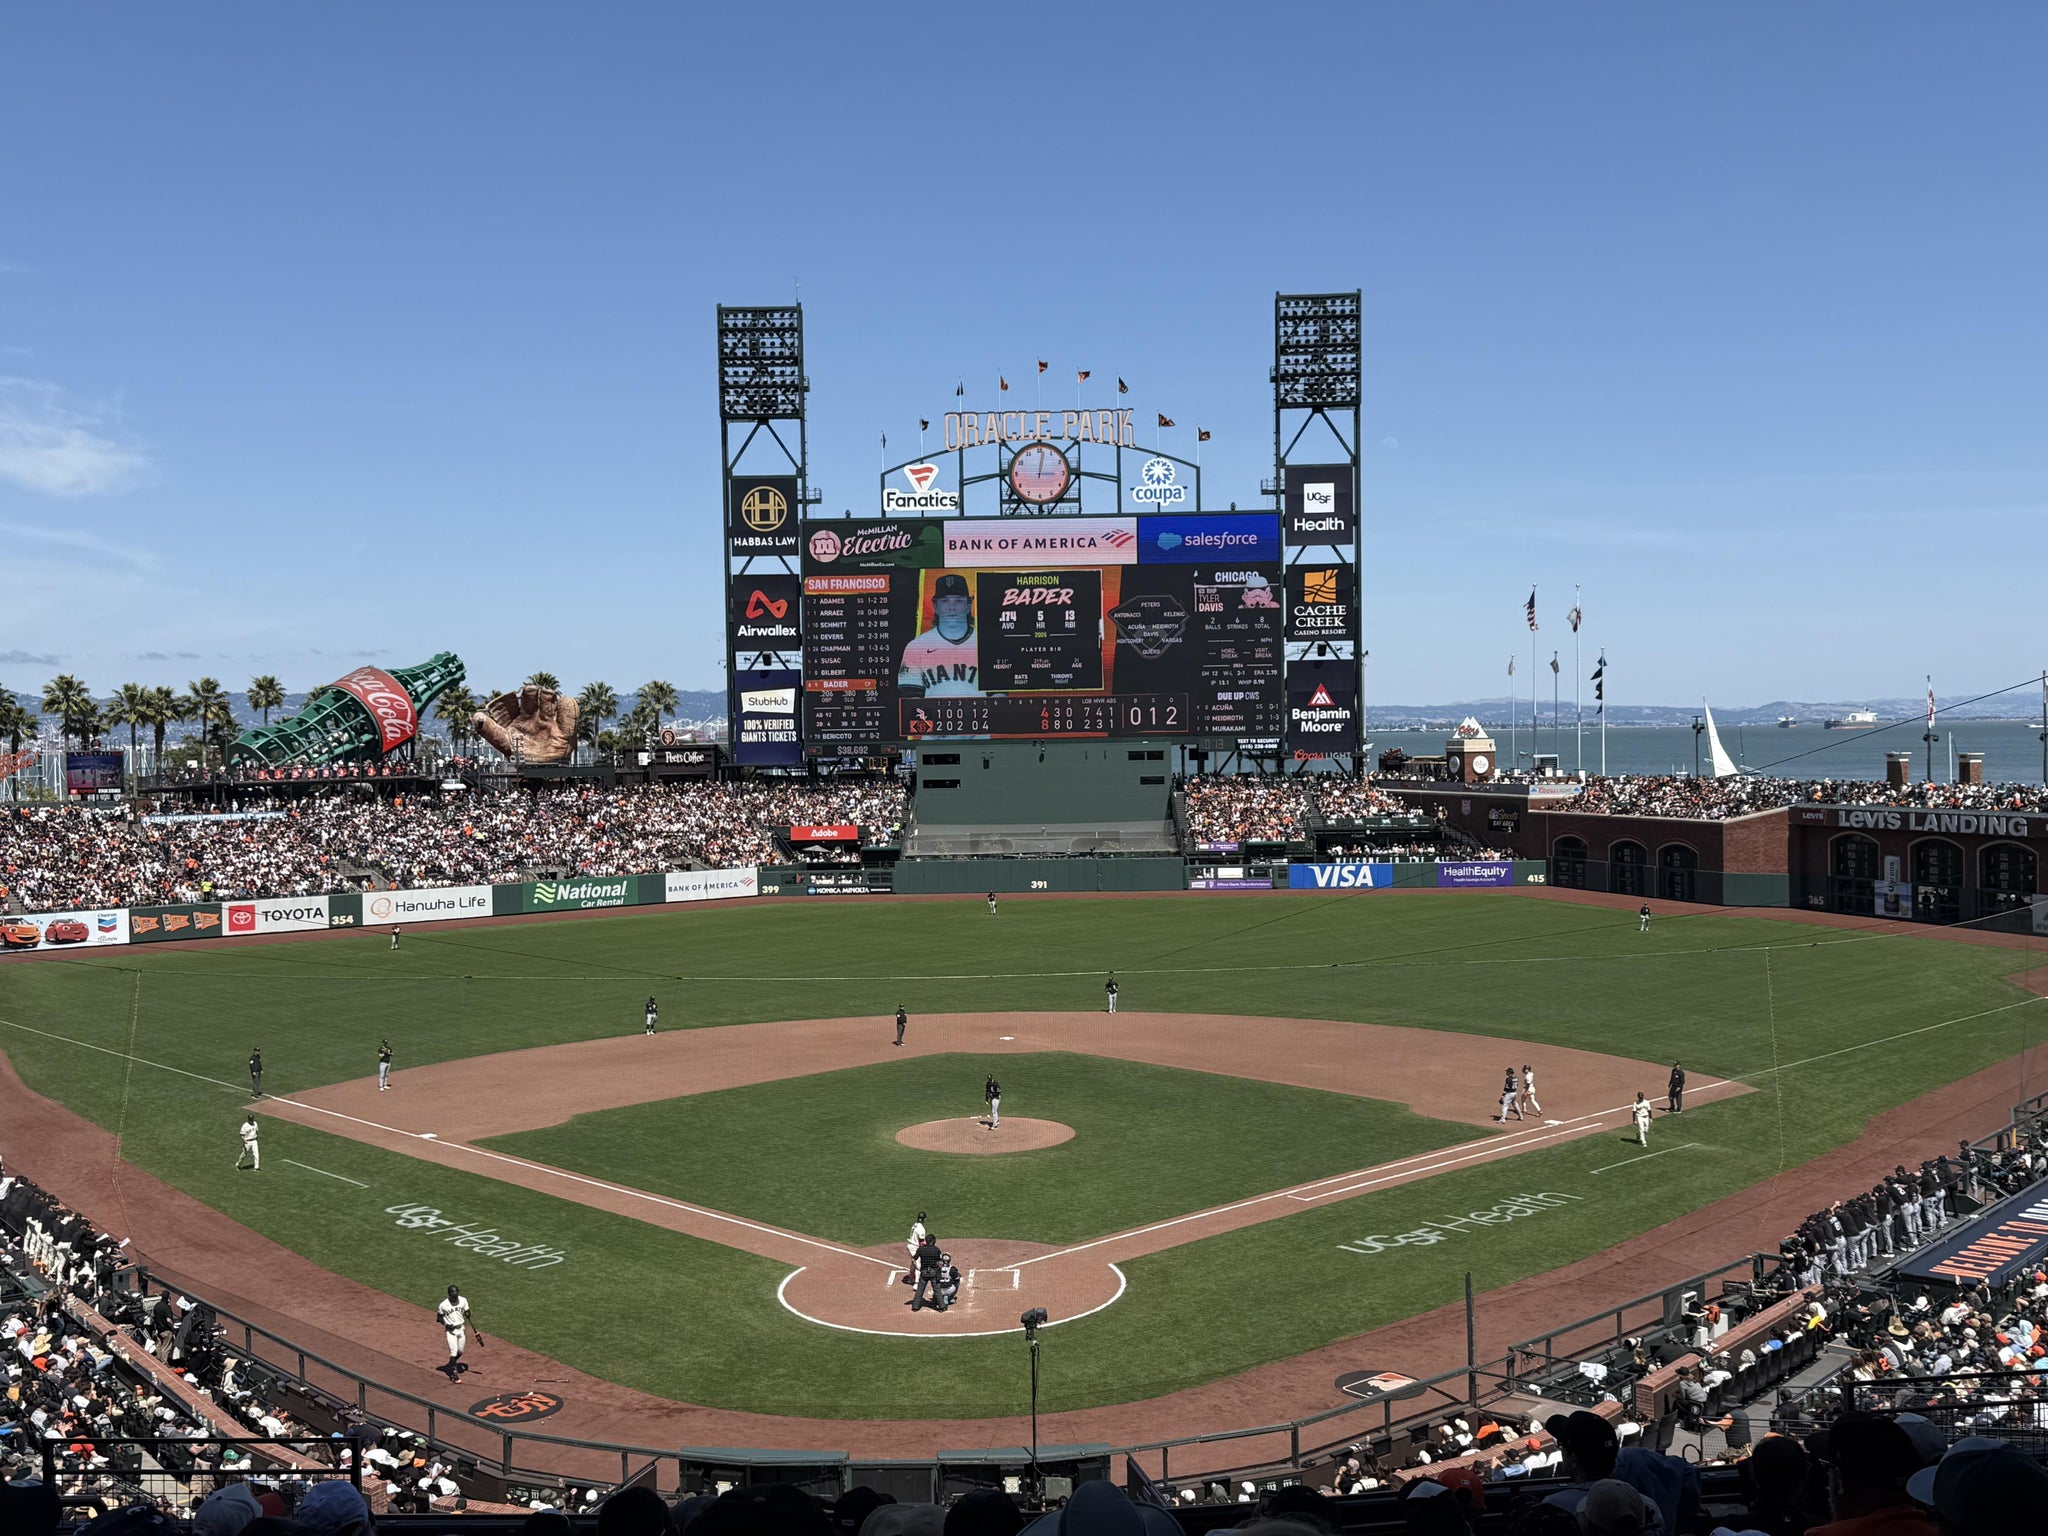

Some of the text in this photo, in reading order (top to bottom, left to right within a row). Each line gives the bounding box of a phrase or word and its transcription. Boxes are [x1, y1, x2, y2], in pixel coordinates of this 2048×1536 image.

[944, 408, 1135, 451] ORACLE PARK
[886, 492, 958, 508] Fanatics
[1136, 488, 1182, 503] coupa
[1307, 492, 1331, 504] UCSF
[857, 524, 897, 536] McMILLAN
[1294, 517, 1344, 531] Health
[734, 536, 796, 546] HABBAS LAW
[842, 530, 912, 556] Electric
[949, 537, 1097, 550] BANK OF AMERICA
[1184, 532, 1258, 549] salesforce
[808, 578, 885, 589] SAN FRANCISCO
[1016, 576, 1059, 585] HARRISON
[1002, 588, 1074, 606] BADER
[1198, 594, 1220, 602] TYLER
[1199, 602, 1224, 612] DAVIS
[1294, 605, 1346, 616] CACHE
[999, 610, 1075, 622] .174 5 13
[1295, 617, 1345, 627] CREEK
[737, 625, 796, 636] Airwallex
[748, 697, 788, 706] StubHub
[1217, 691, 1260, 700] DUE UP CWS
[937, 709, 941, 719] 1
[946, 709, 953, 719] 0
[957, 709, 963, 719] 0
[973, 708, 977, 718] 1
[982, 708, 988, 718] 2
[1041, 707, 1048, 718] 4
[1054, 707, 1061, 718] 3
[1066, 707, 1073, 717] 0
[1084, 707, 1090, 717] 7
[1096, 707, 1103, 717] 4
[1130, 706, 1177, 726] 0 1 2
[1292, 707, 1350, 722] Benjamin
[743, 719, 794, 730] 100% VERIFIED
[936, 721, 943, 731] 2
[946, 721, 953, 731] 0
[957, 720, 963, 731] 2
[972, 720, 979, 731] 0
[982, 720, 989, 730] 4
[1041, 719, 1049, 730] 8
[1054, 719, 1061, 730] 8
[1066, 719, 1073, 730] 0
[1084, 719, 1090, 729] 2
[1096, 719, 1103, 729] 3
[1301, 721, 1342, 732] Moore
[741, 731, 797, 742] GIANTS TICKETS
[683, 751, 705, 763] Coffee
[1909, 812, 2028, 836] LANDING
[810, 829, 838, 837] Adobe
[1308, 866, 1373, 887] VISA
[1444, 867, 1506, 878] HealthEquity
[1527, 874, 1545, 882] 415
[557, 881, 627, 900] National
[703, 881, 738, 891] AMERICA
[1031, 881, 1047, 889] 391
[395, 896, 486, 913] Hanwha Life
[581, 898, 624, 908] Car Rental
[1808, 895, 1824, 905] 365
[262, 907, 324, 922] TOYOTA
[331, 915, 354, 925] 354
[1421, 1192, 1583, 1233] Health
[426, 1222, 565, 1270] Health
[1929, 1233, 2039, 1278] WELCOME
